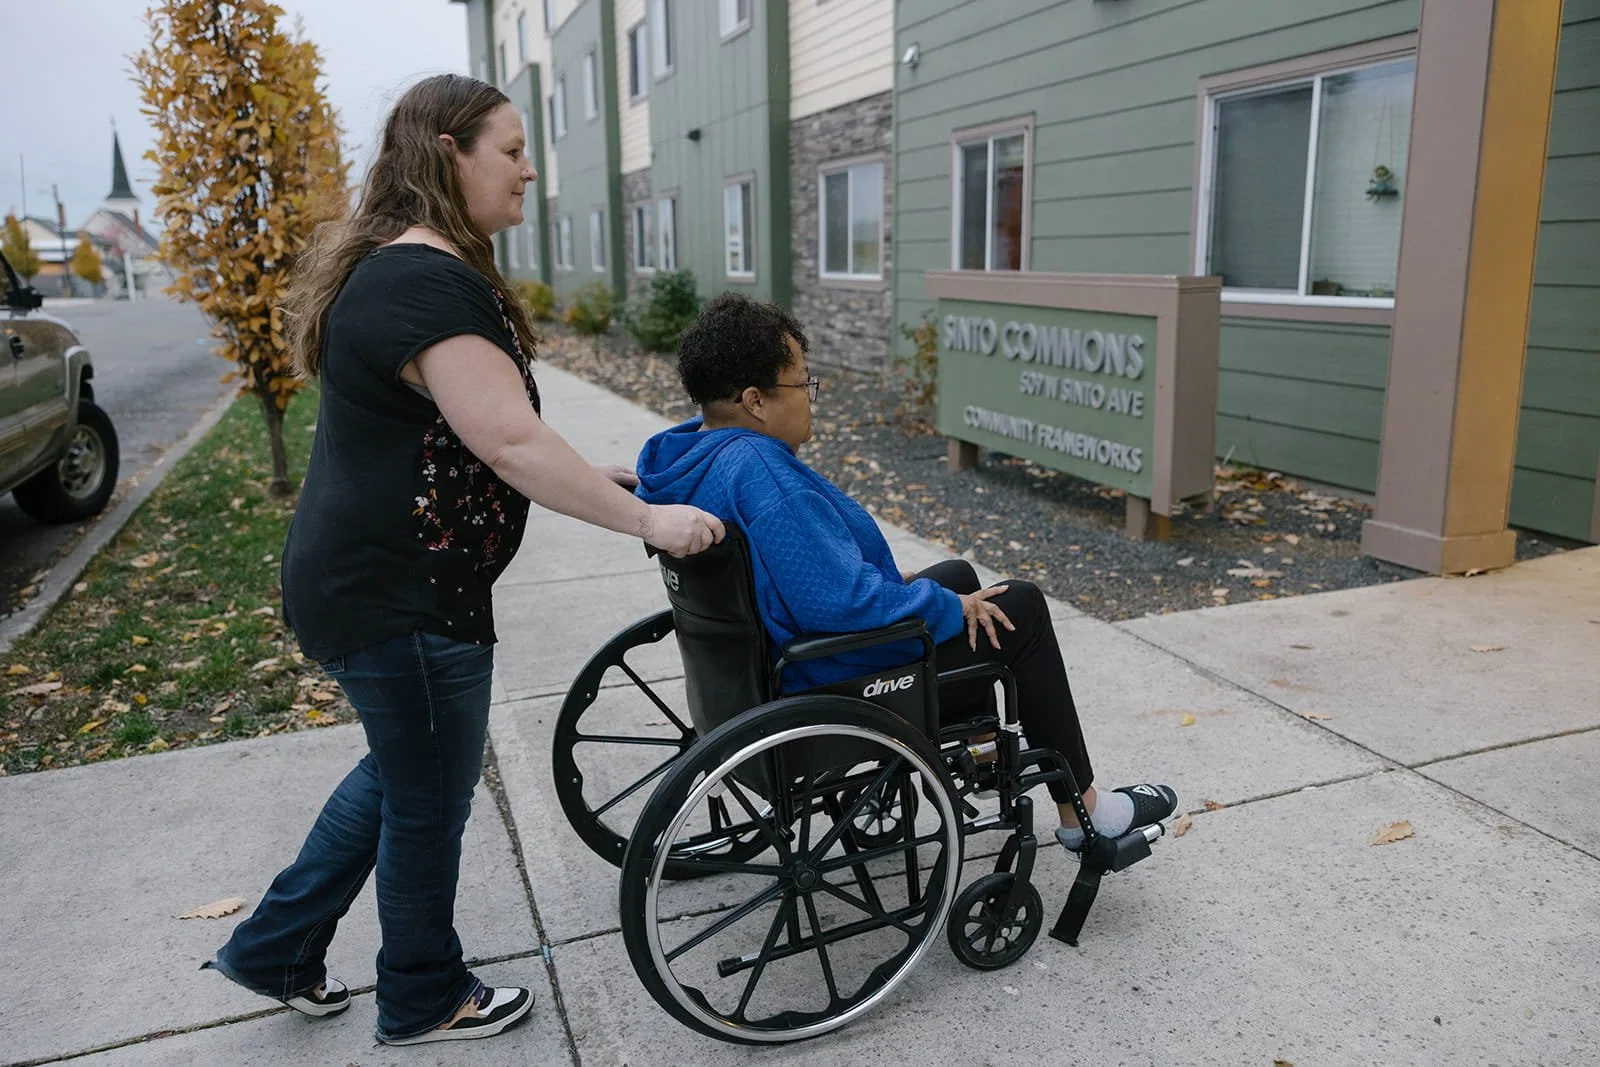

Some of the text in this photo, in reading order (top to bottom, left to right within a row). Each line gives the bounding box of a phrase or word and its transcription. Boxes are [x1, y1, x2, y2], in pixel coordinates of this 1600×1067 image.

[1002, 321, 1143, 378] COMMONS
[1107, 388, 1144, 417] AVE
[964, 405, 1142, 472] COMMUNITY FRAMEWORKS
[863, 675, 914, 697] drive
